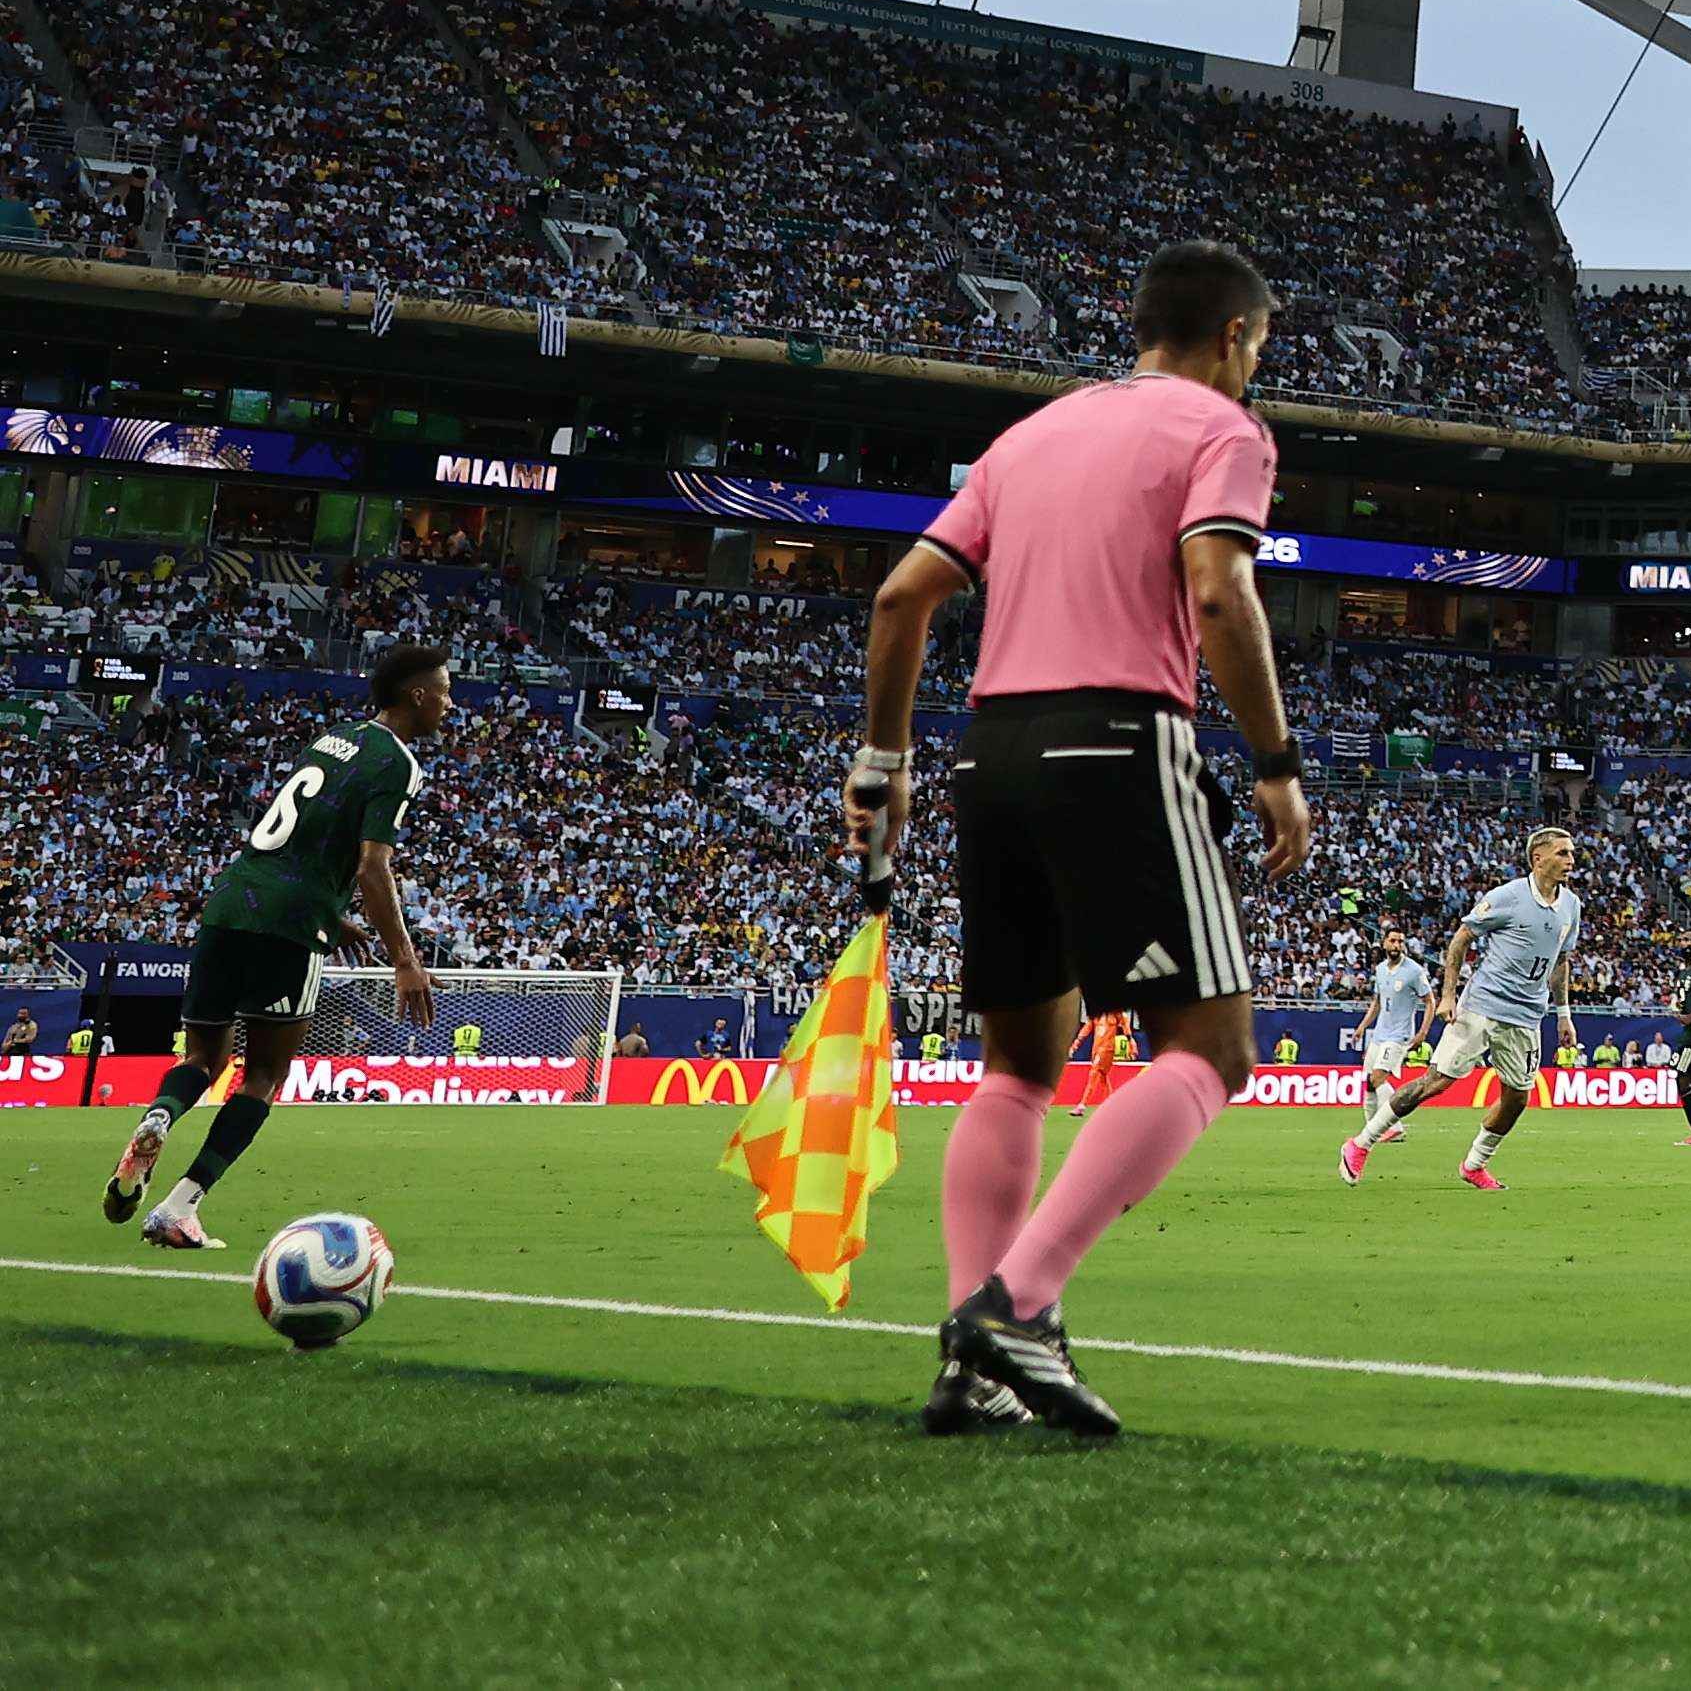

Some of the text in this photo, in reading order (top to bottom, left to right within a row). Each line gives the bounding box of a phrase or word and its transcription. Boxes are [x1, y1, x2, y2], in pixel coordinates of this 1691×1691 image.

[1291, 80, 1324, 103] 308
[435, 454, 557, 492] MIAMI
[1255, 534, 1301, 563] 26
[250, 765, 325, 851] 6
[1528, 956, 1549, 982] 13
